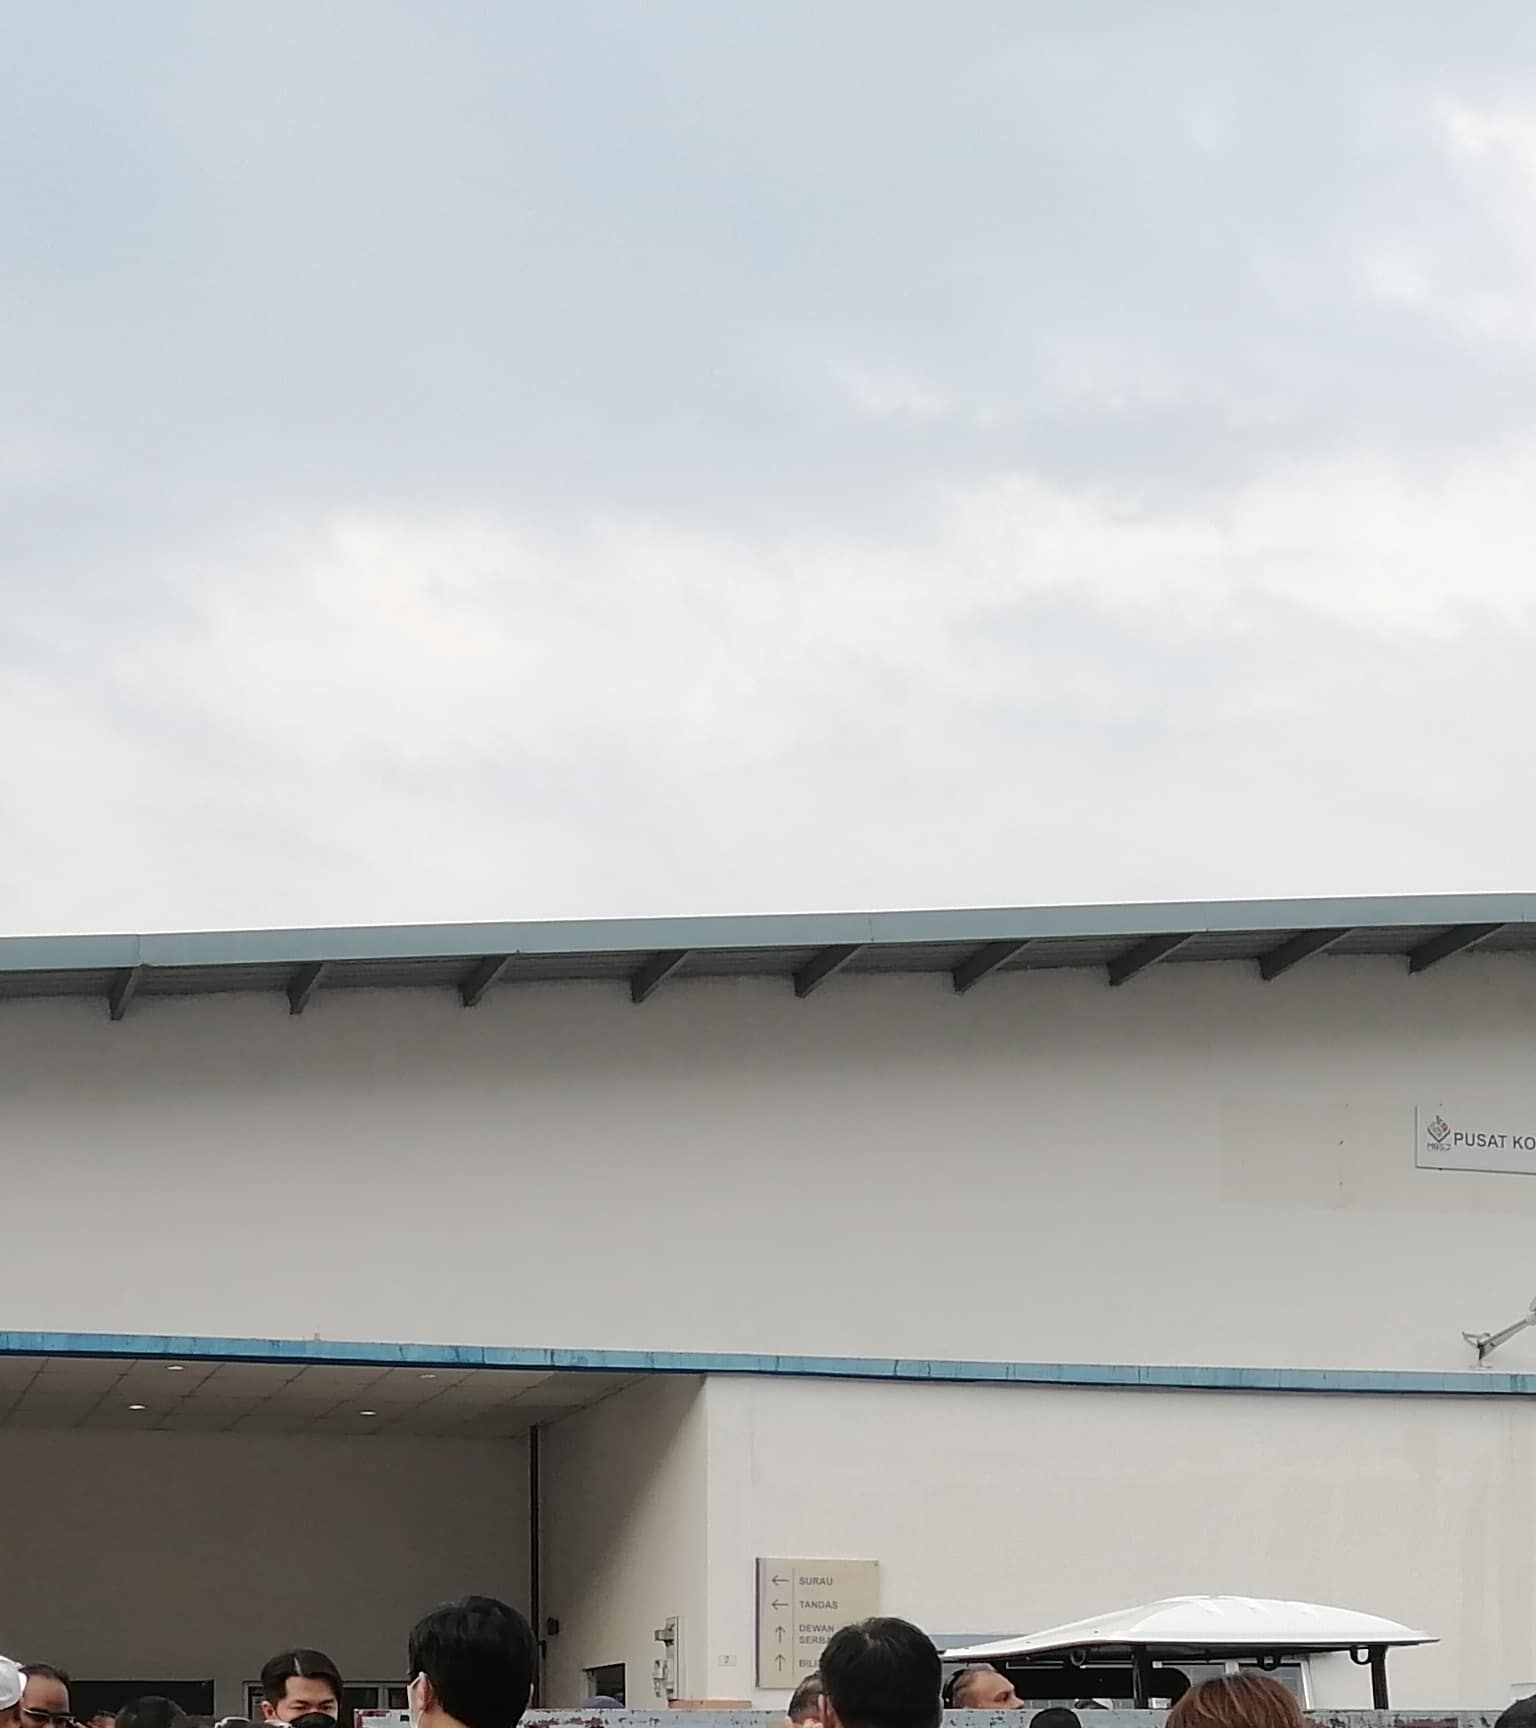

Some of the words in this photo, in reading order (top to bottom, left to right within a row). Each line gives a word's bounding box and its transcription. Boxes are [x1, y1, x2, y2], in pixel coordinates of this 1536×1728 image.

[1454, 1132, 1507, 1149] PUSAT
[799, 1577, 833, 1586] SURAU
[799, 1600, 838, 1609] TANDAS
[799, 1624, 835, 1632] DEWAN
